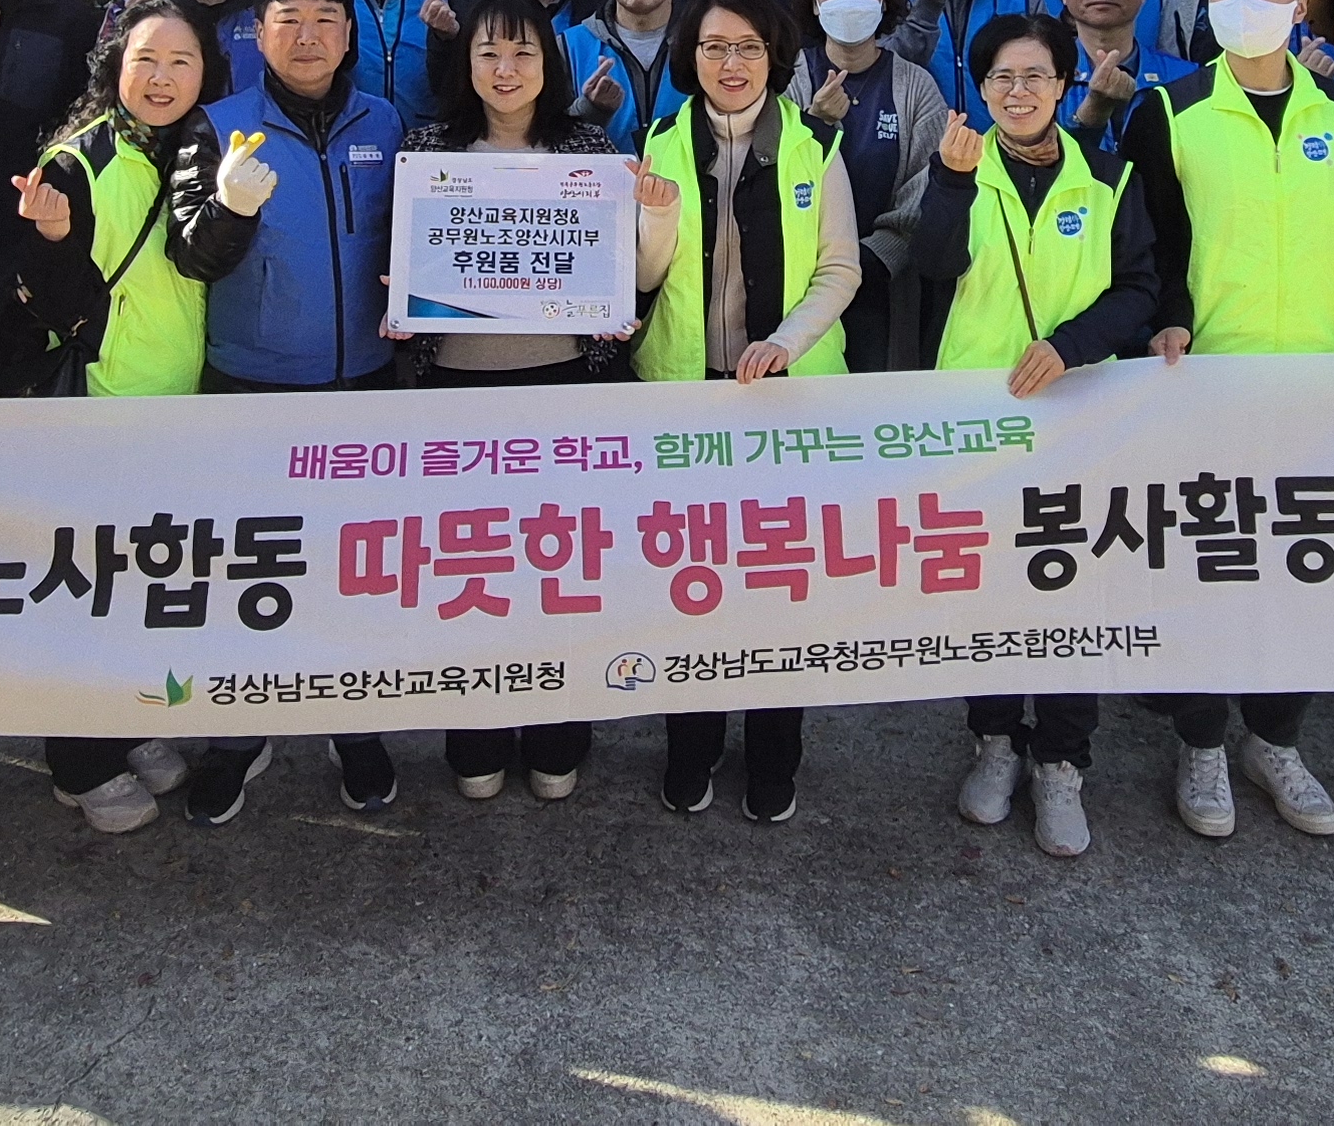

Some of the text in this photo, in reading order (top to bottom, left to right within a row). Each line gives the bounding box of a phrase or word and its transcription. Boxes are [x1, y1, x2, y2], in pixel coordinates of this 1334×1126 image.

[450, 207, 580, 225] 양산교육지원청&
[428, 228, 600, 247] 공무원노조양산시지부
[452, 250, 575, 274] 후원품 전달
[535, 277, 562, 291] 상당)
[288, 416, 1036, 481] 배움이 즐거운 학교, 함께 가꾸는 양산교육
[338, 503, 614, 622] 따뜻한
[637, 493, 990, 617] 행복나눔
[664, 625, 1162, 684] 경상남도교육청공무원노동조합양산지부
[207, 661, 566, 706] 경상남도양산교육지원청
